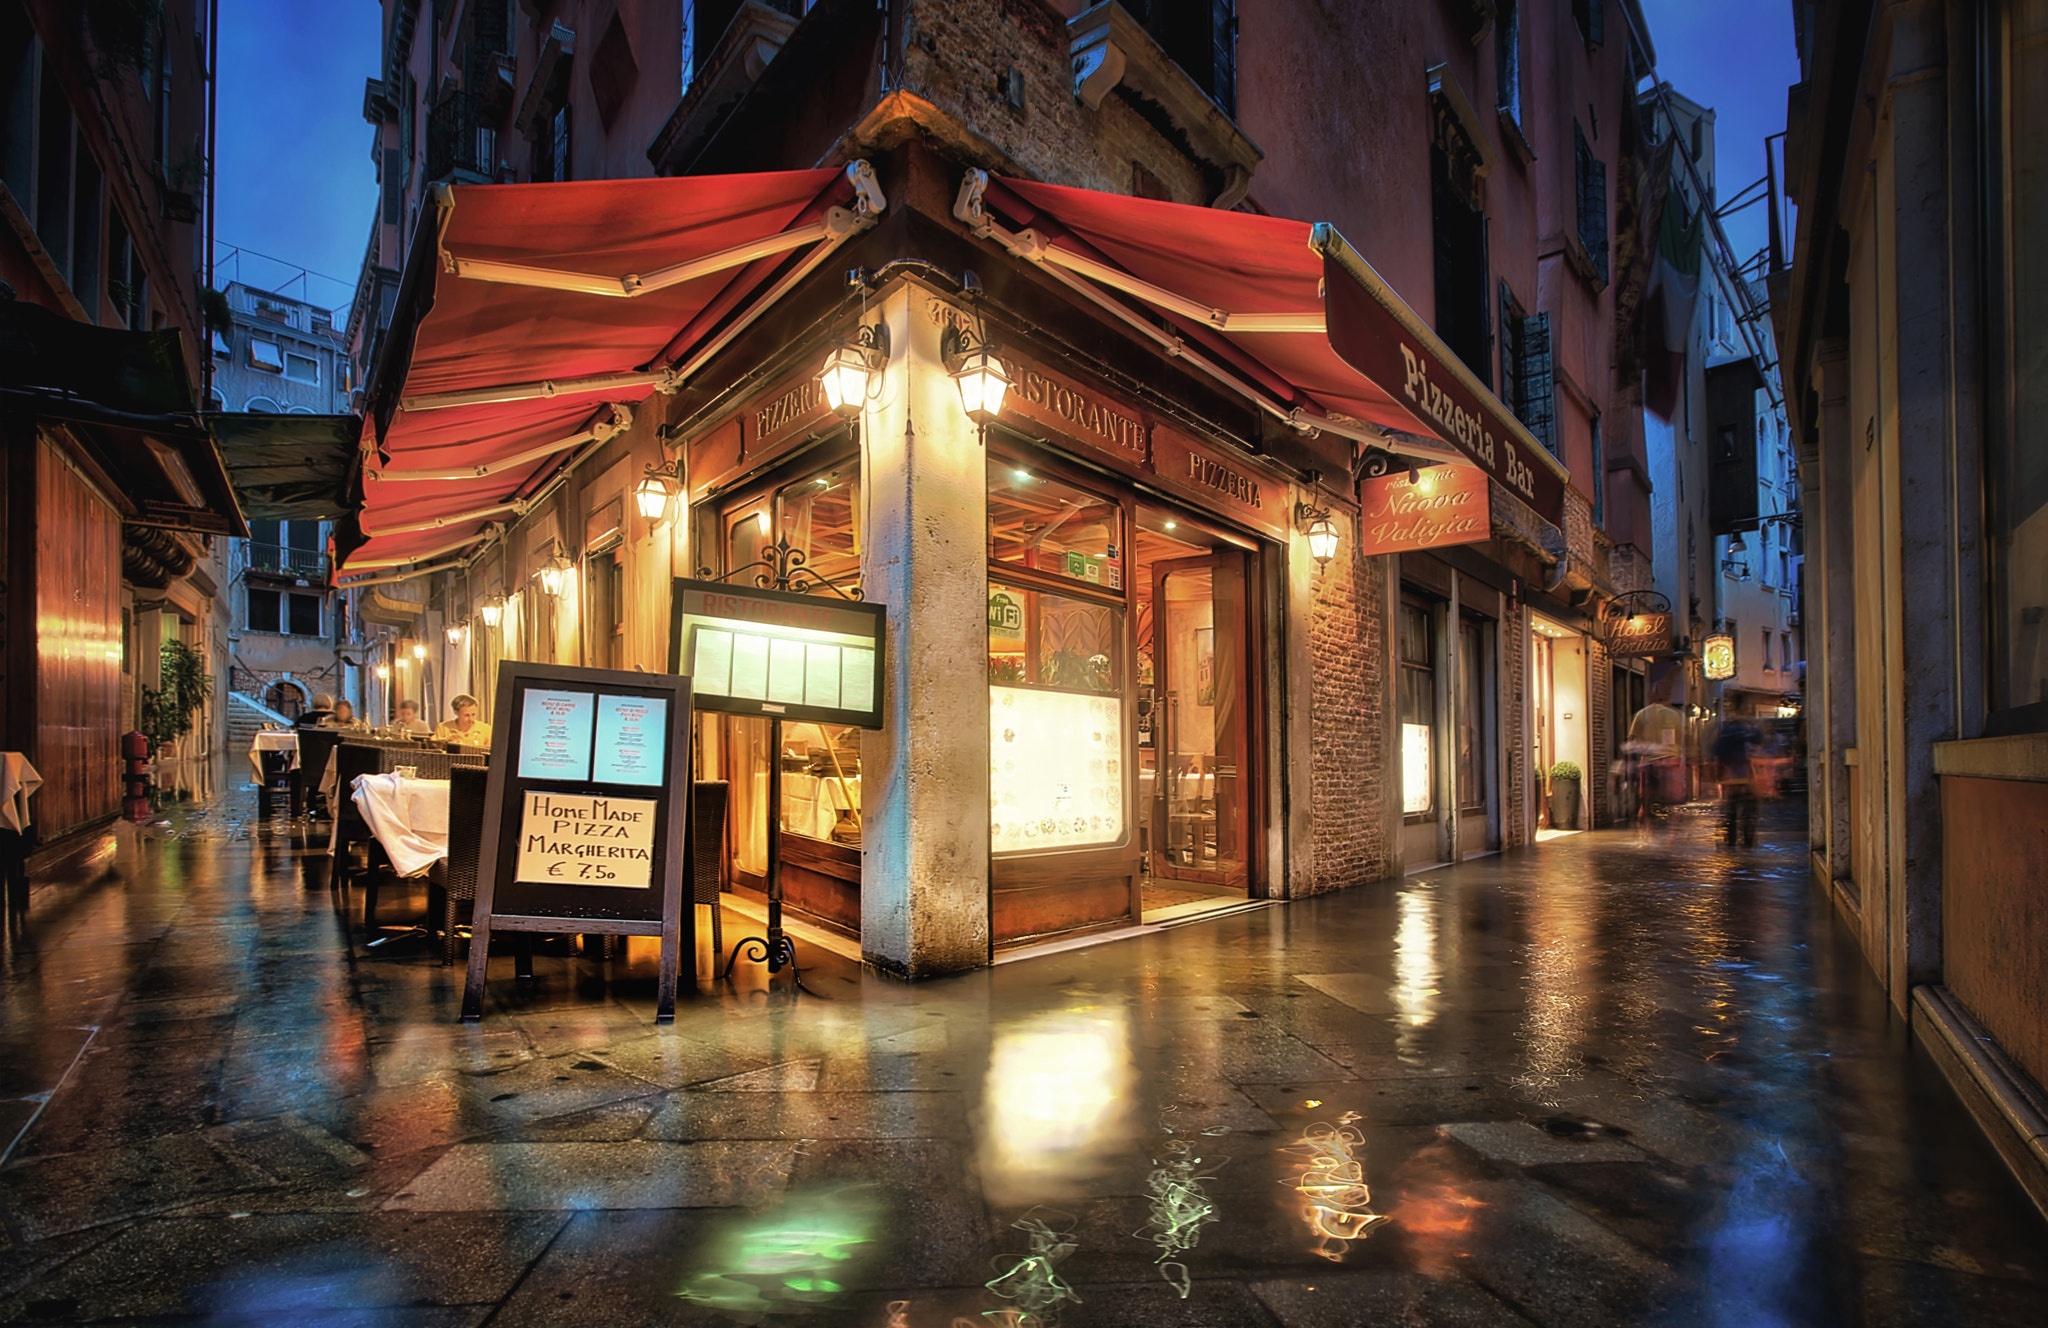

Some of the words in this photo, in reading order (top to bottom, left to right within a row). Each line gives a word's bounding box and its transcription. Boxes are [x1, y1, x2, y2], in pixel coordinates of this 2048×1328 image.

[756, 381, 823, 440] PIZZERI
[1400, 342, 1496, 470] Pizzeria
[1504, 440, 1535, 500] Bar
[1189, 451, 1263, 509] PIZZERIA
[1370, 490, 1475, 518] Nuova
[1371, 514, 1479, 546] Valigia
[702, 593, 834, 630] RISTORANTE
[1610, 616, 1667, 638] Hotel
[553, 820, 630, 838] PIZZA
[527, 834, 650, 860] MARGHERITA
